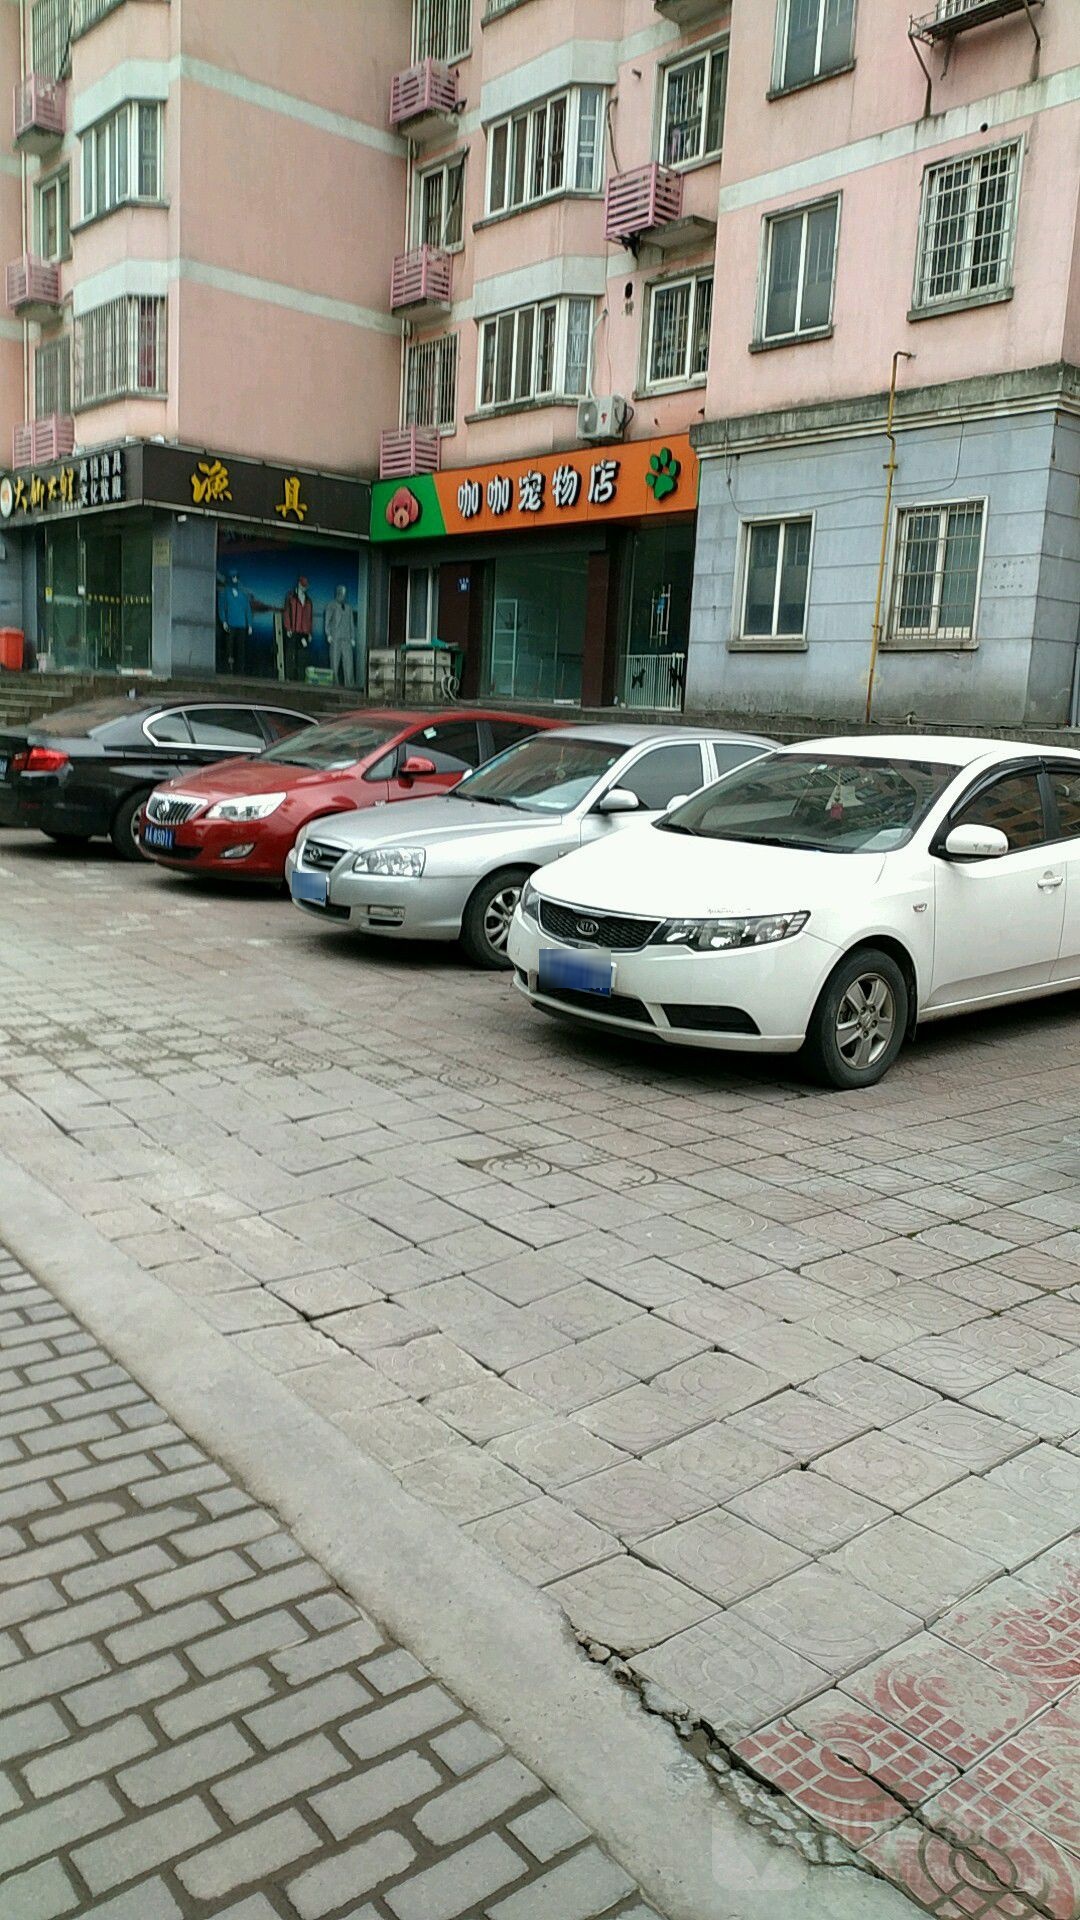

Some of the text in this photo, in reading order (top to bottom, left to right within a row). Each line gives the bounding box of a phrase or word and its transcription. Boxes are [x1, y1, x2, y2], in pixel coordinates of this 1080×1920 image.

[191, 460, 308, 521] 渔具
[457, 459, 618, 518] 咖咖宠物店
